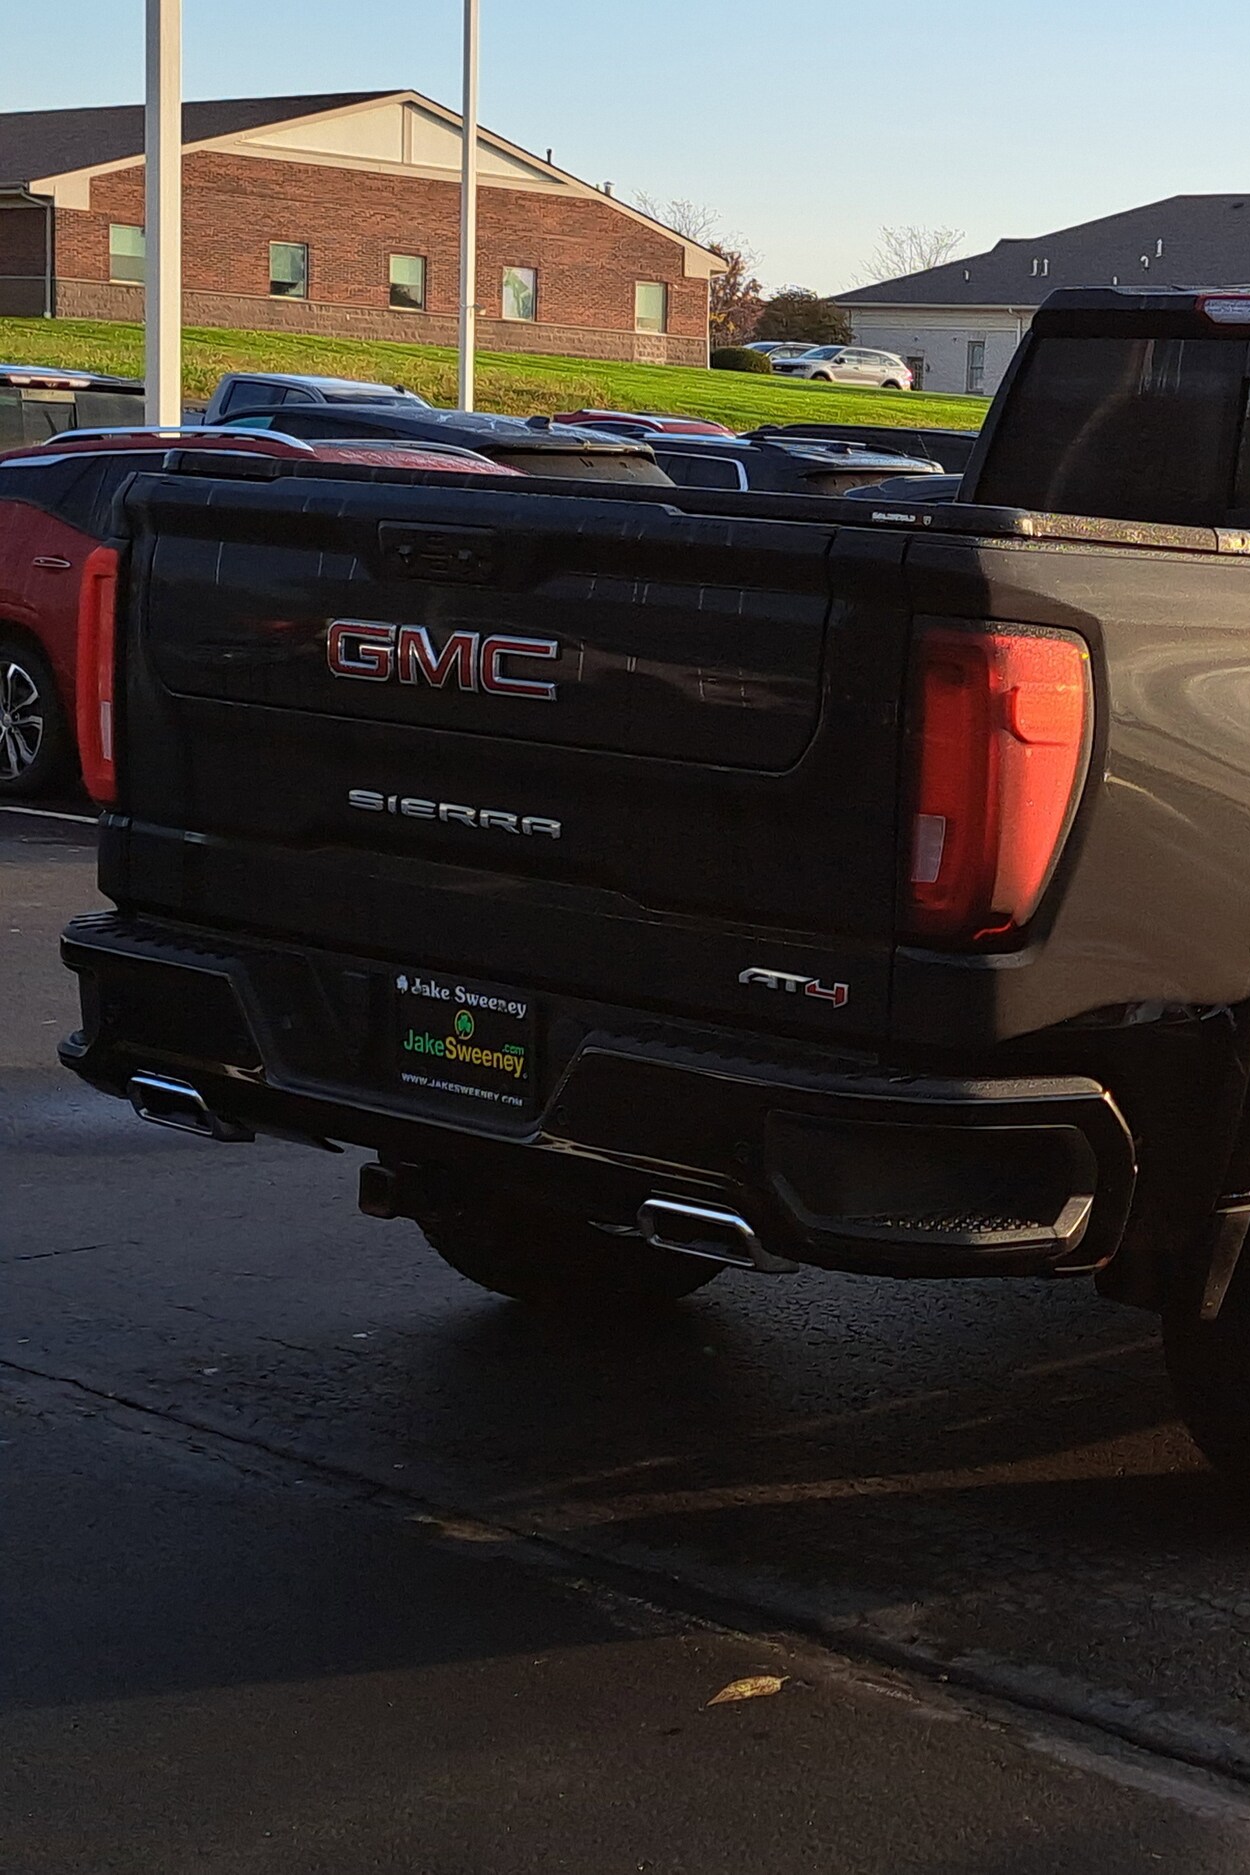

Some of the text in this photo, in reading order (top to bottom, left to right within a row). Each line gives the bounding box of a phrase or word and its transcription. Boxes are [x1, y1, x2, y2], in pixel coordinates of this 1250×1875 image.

[327, 618, 559, 700] GMC
[349, 789, 562, 840] SIERRA
[411, 977, 527, 1019] Jake Sweeney
[738, 966, 849, 1009] AT4
[401, 1073, 523, 1107] WWW.JAKESWEENEYCOM
